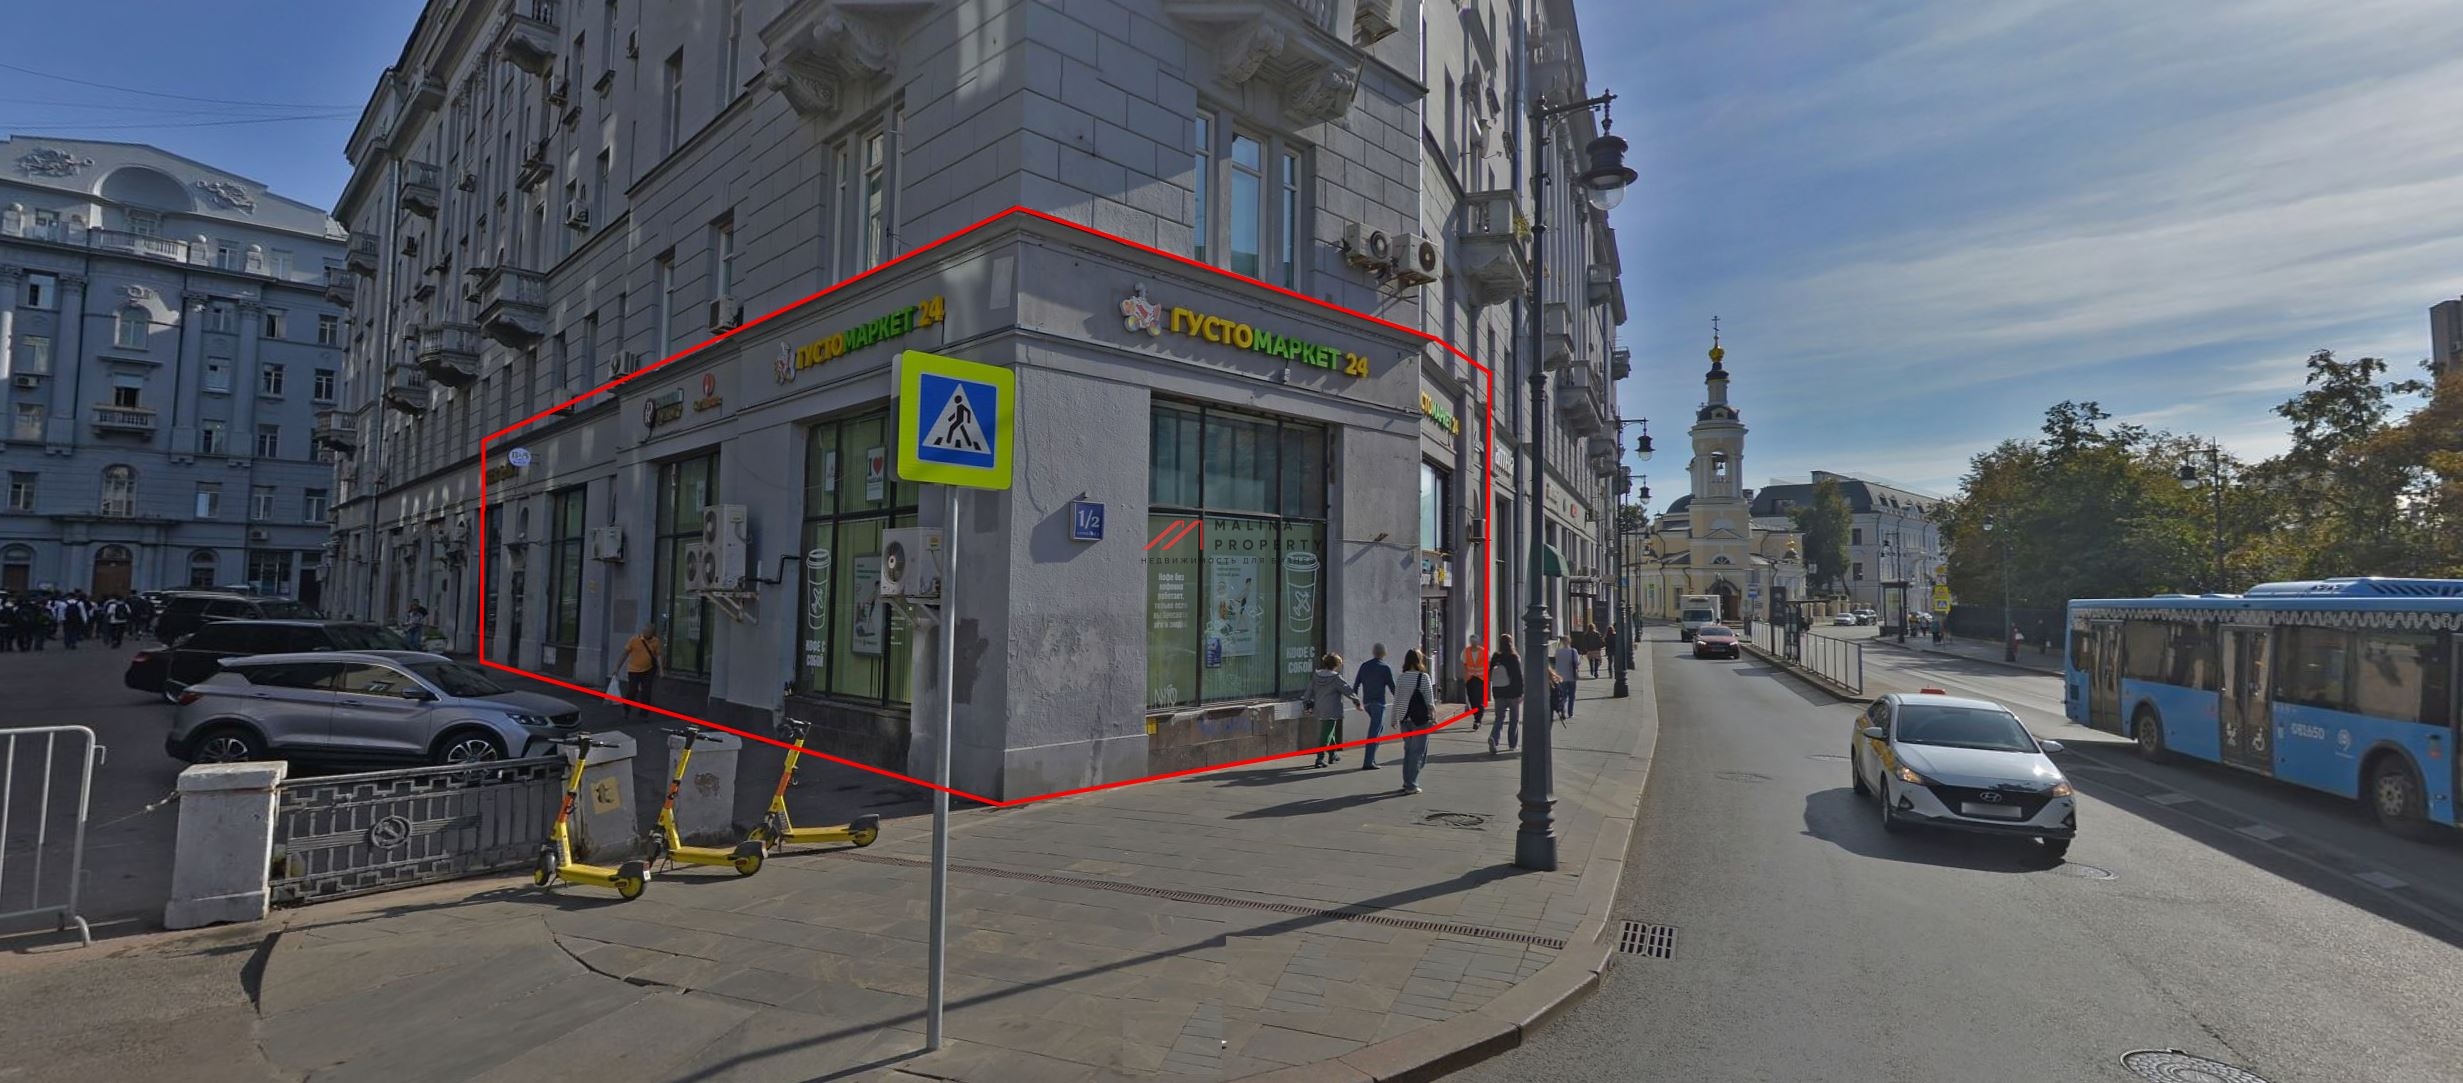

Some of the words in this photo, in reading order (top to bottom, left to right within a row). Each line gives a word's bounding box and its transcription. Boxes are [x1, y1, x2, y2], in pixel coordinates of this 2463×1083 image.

[796, 306, 917, 369] ГУСТОМАРКЕТ
[918, 295, 945, 327] 24
[1170, 306, 1342, 370] ГУСТОМАРКЕТ
[1344, 352, 1369, 378] 24
[1078, 509, 1100, 529] 1/2
[1286, 646, 1309, 659] КОФЕ
[1288, 658, 1313, 673] СОБОЙ
